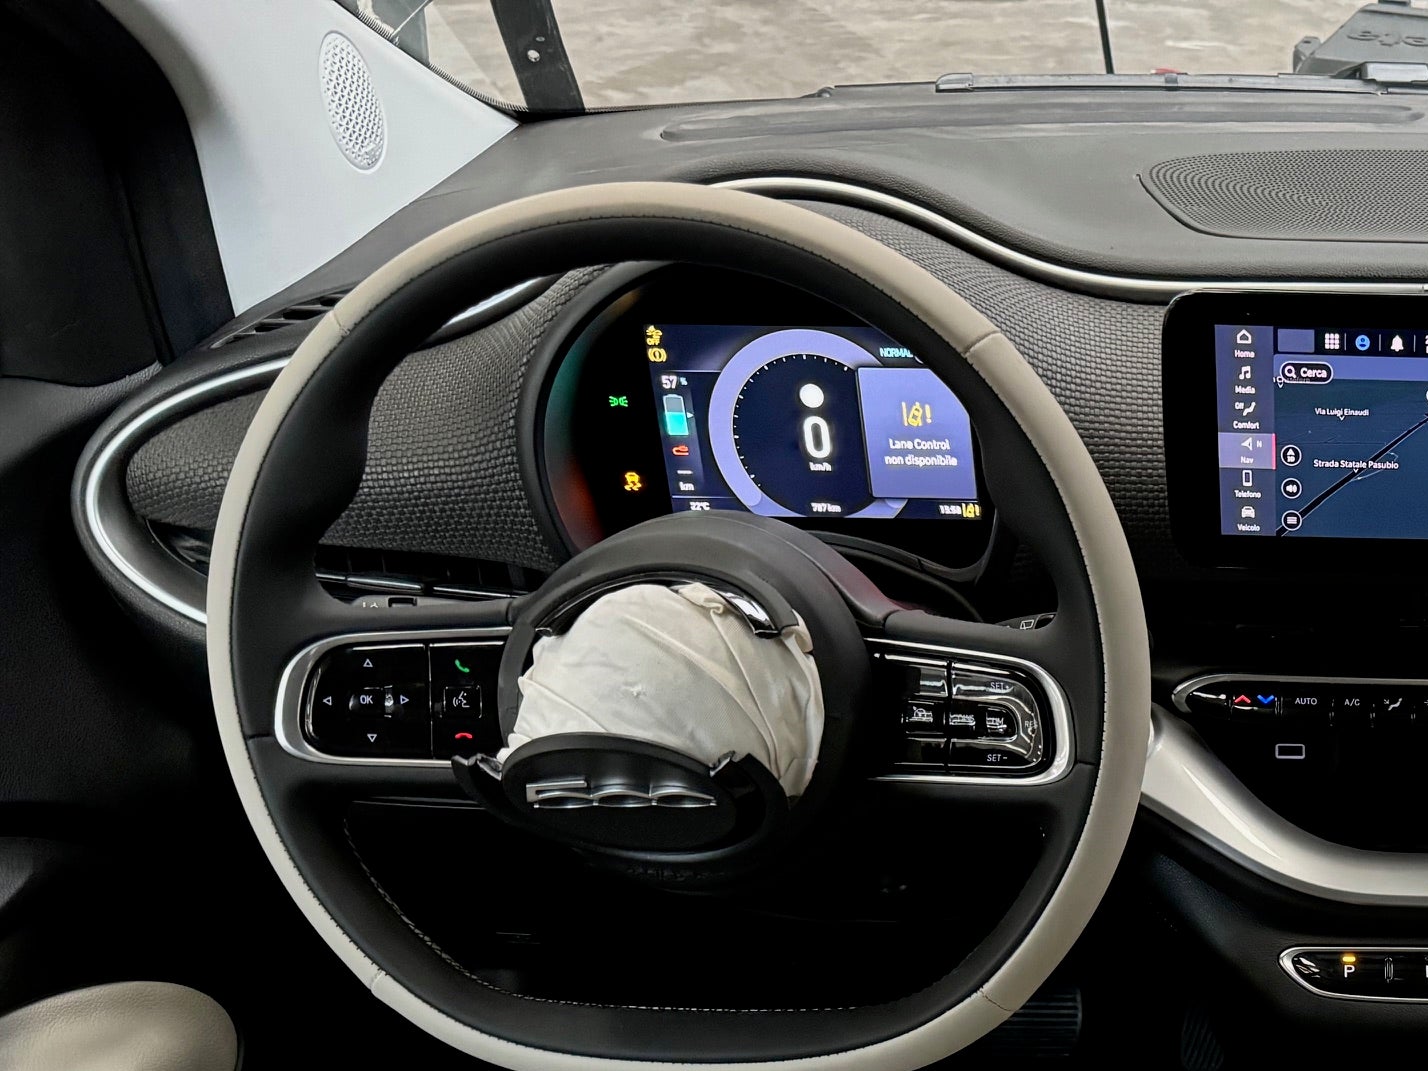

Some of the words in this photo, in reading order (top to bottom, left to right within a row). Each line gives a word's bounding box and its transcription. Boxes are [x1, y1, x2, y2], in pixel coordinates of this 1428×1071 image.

[879, 347, 913, 359] NORMAL
[1234, 349, 1255, 358] Home
[1300, 367, 1327, 378] Cerca
[662, 376, 677, 389] 57
[1235, 385, 1256, 394] Media
[1314, 408, 1326, 416] Via
[1326, 408, 1343, 417] Luigi
[1233, 420, 1260, 430] Comfort
[803, 415, 832, 459] 0
[889, 439, 914, 450] Lane
[915, 439, 950, 450] Control
[884, 455, 904, 466] non
[906, 454, 957, 467] disponibile
[1240, 456, 1254, 464] Nav
[1313, 459, 1339, 468] Strada
[1340, 460, 1367, 469] Statale
[1368, 461, 1399, 470] Pasubio
[679, 481, 694, 491] km
[1234, 490, 1261, 499] Telefono
[1237, 524, 1260, 532] Veicolo
[360, 695, 373, 704] OK
[1295, 698, 1318, 706] AUTO
[1344, 699, 1361, 707] A/C
[1344, 965, 1356, 978] P
